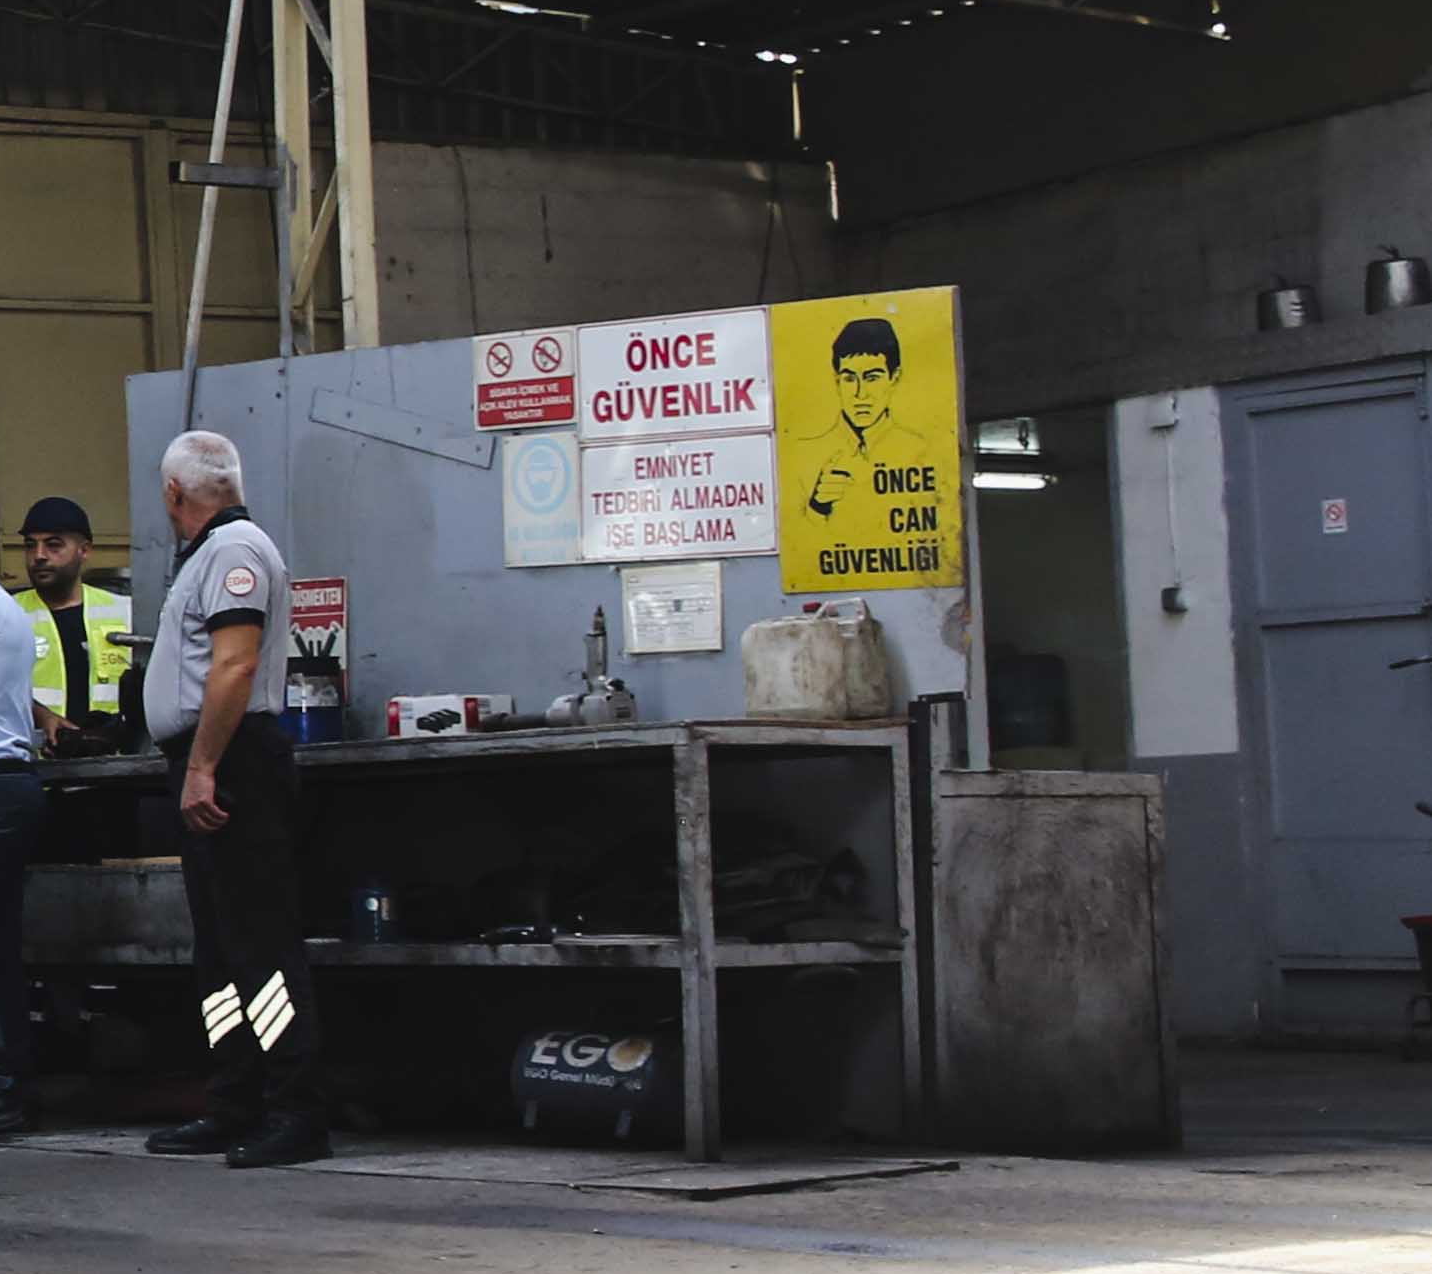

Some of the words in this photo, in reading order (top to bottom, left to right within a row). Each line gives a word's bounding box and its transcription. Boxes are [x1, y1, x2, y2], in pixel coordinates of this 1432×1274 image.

[626, 331, 717, 373] ÖNCE
[873, 463, 936, 495] ÖNCE
[670, 482, 765, 511] ALMADAN
[644, 517, 737, 547] BAŞLAMA
[889, 506, 938, 533] CAN
[819, 538, 940, 575] GÜVENLİĞİ
